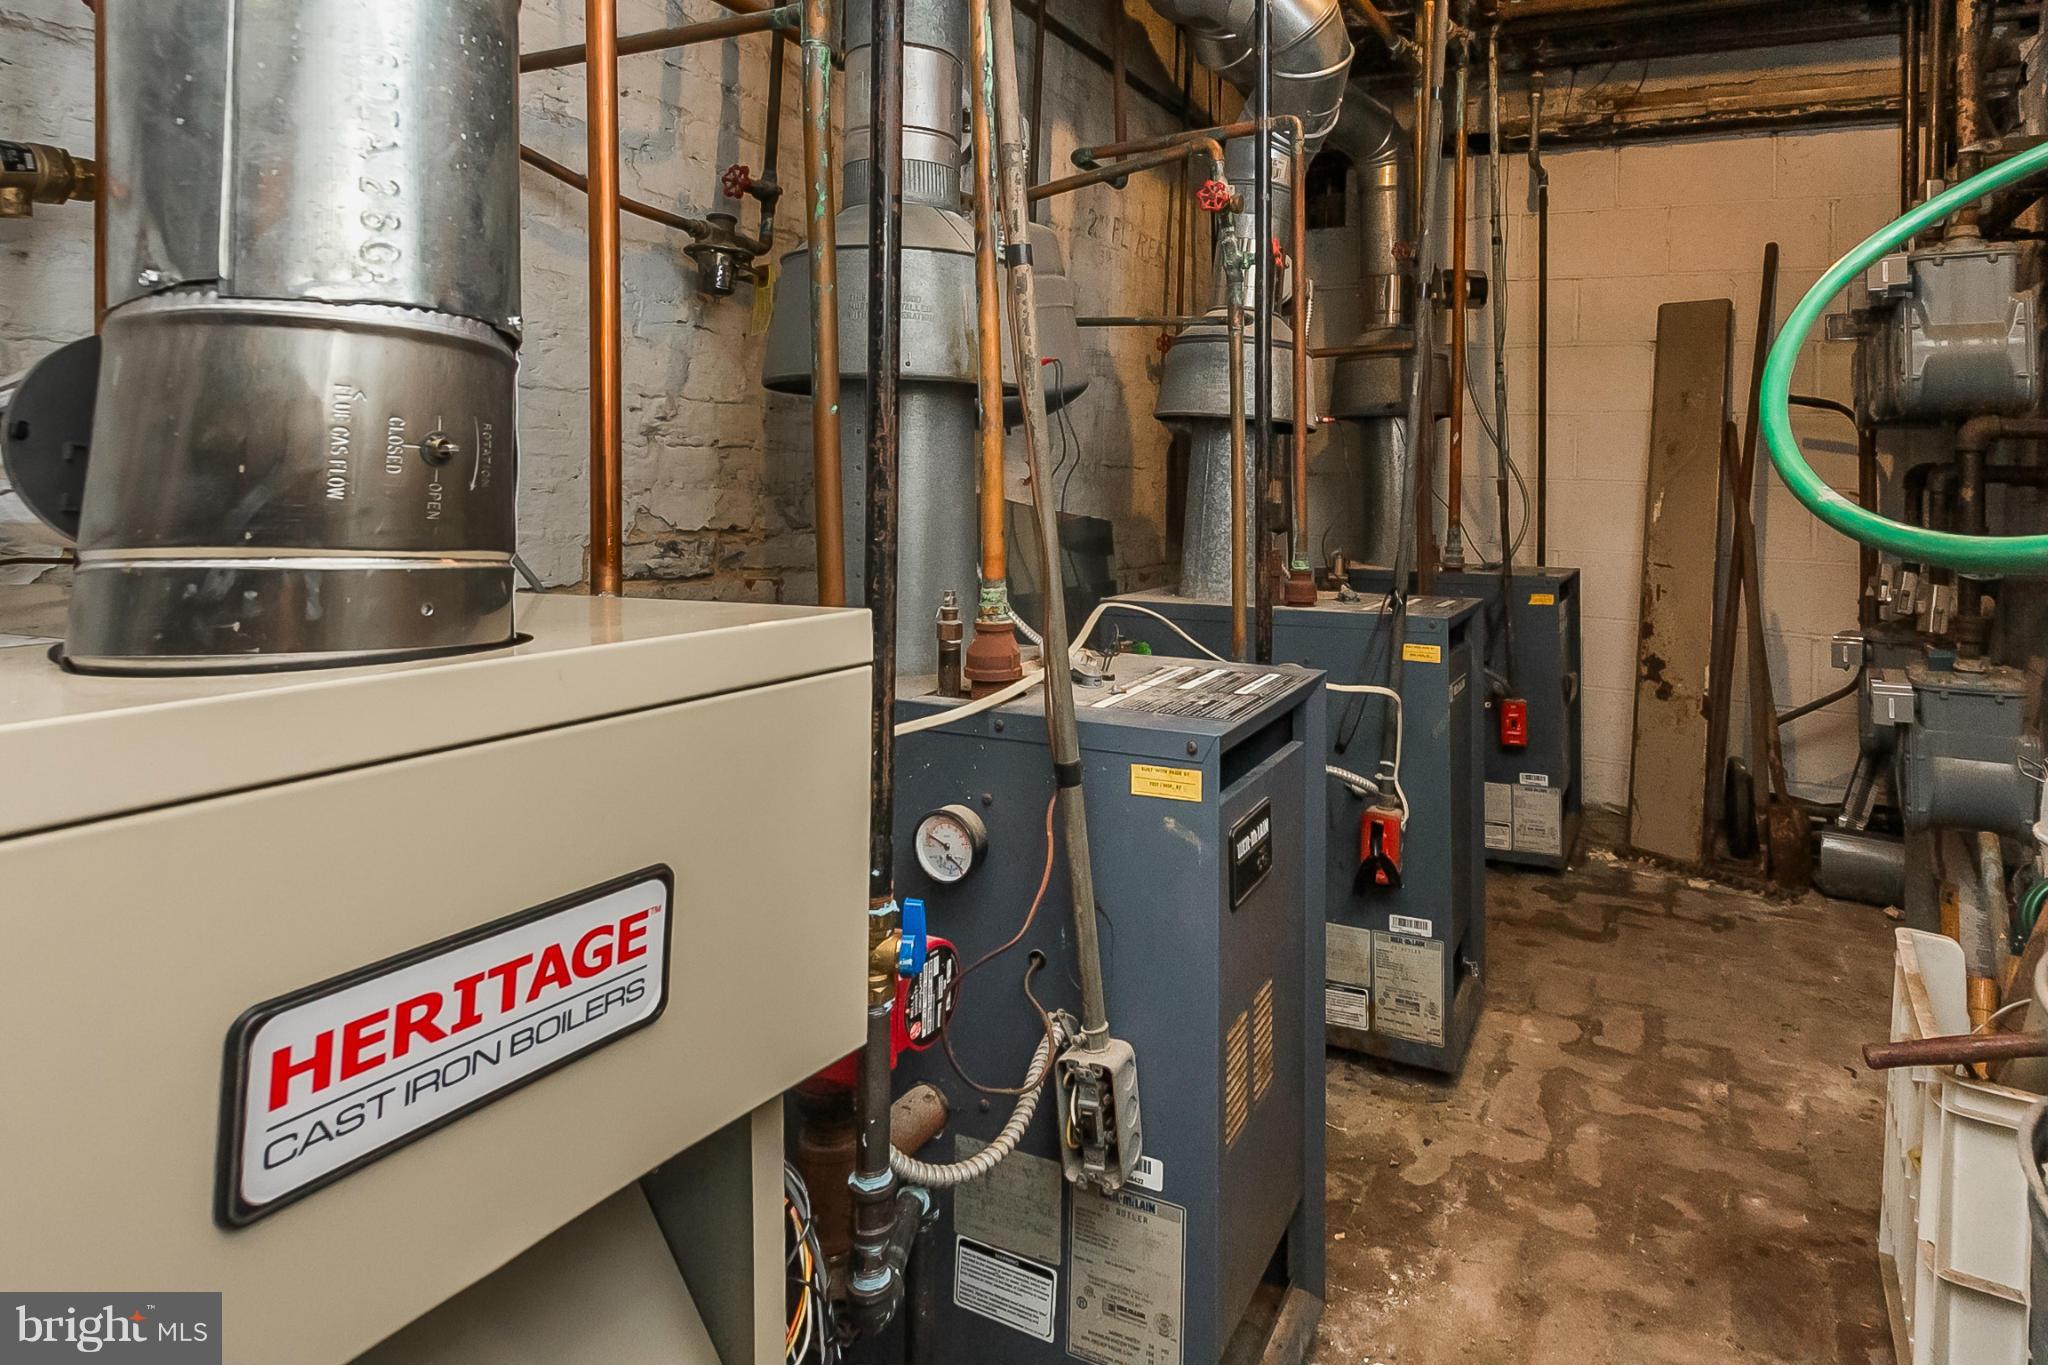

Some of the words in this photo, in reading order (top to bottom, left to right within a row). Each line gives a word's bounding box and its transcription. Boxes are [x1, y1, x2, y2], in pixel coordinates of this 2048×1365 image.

[329, 426, 351, 456] GAS
[385, 416, 406, 475] CLOSED
[480, 422, 493, 488] ROTATION
[325, 459, 347, 500] FLOW
[426, 482, 443, 520] OPEN
[268, 909, 650, 1112] HERITAGE
[263, 1087, 397, 1171] CAST
[403, 1039, 501, 1107] IRON
[509, 978, 646, 1058] BOILERS
